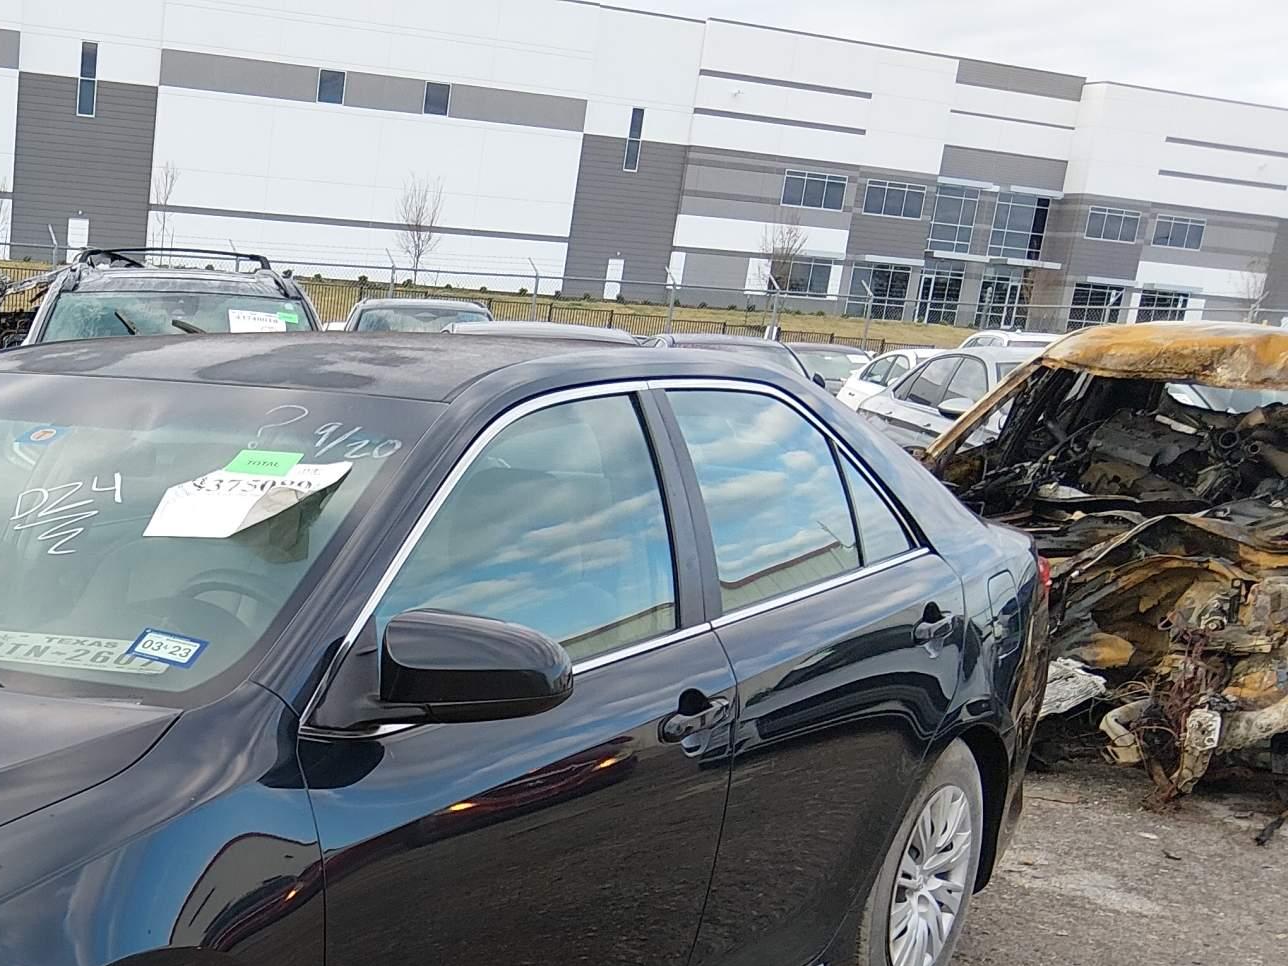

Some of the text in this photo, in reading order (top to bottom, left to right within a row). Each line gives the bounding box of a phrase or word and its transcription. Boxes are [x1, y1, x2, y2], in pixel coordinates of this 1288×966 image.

[313, 421, 403, 459] 9/20
[247, 459, 281, 469] TOTAL
[46, 636, 119, 649] TEXAS
[141, 638, 193, 659] 03 23
